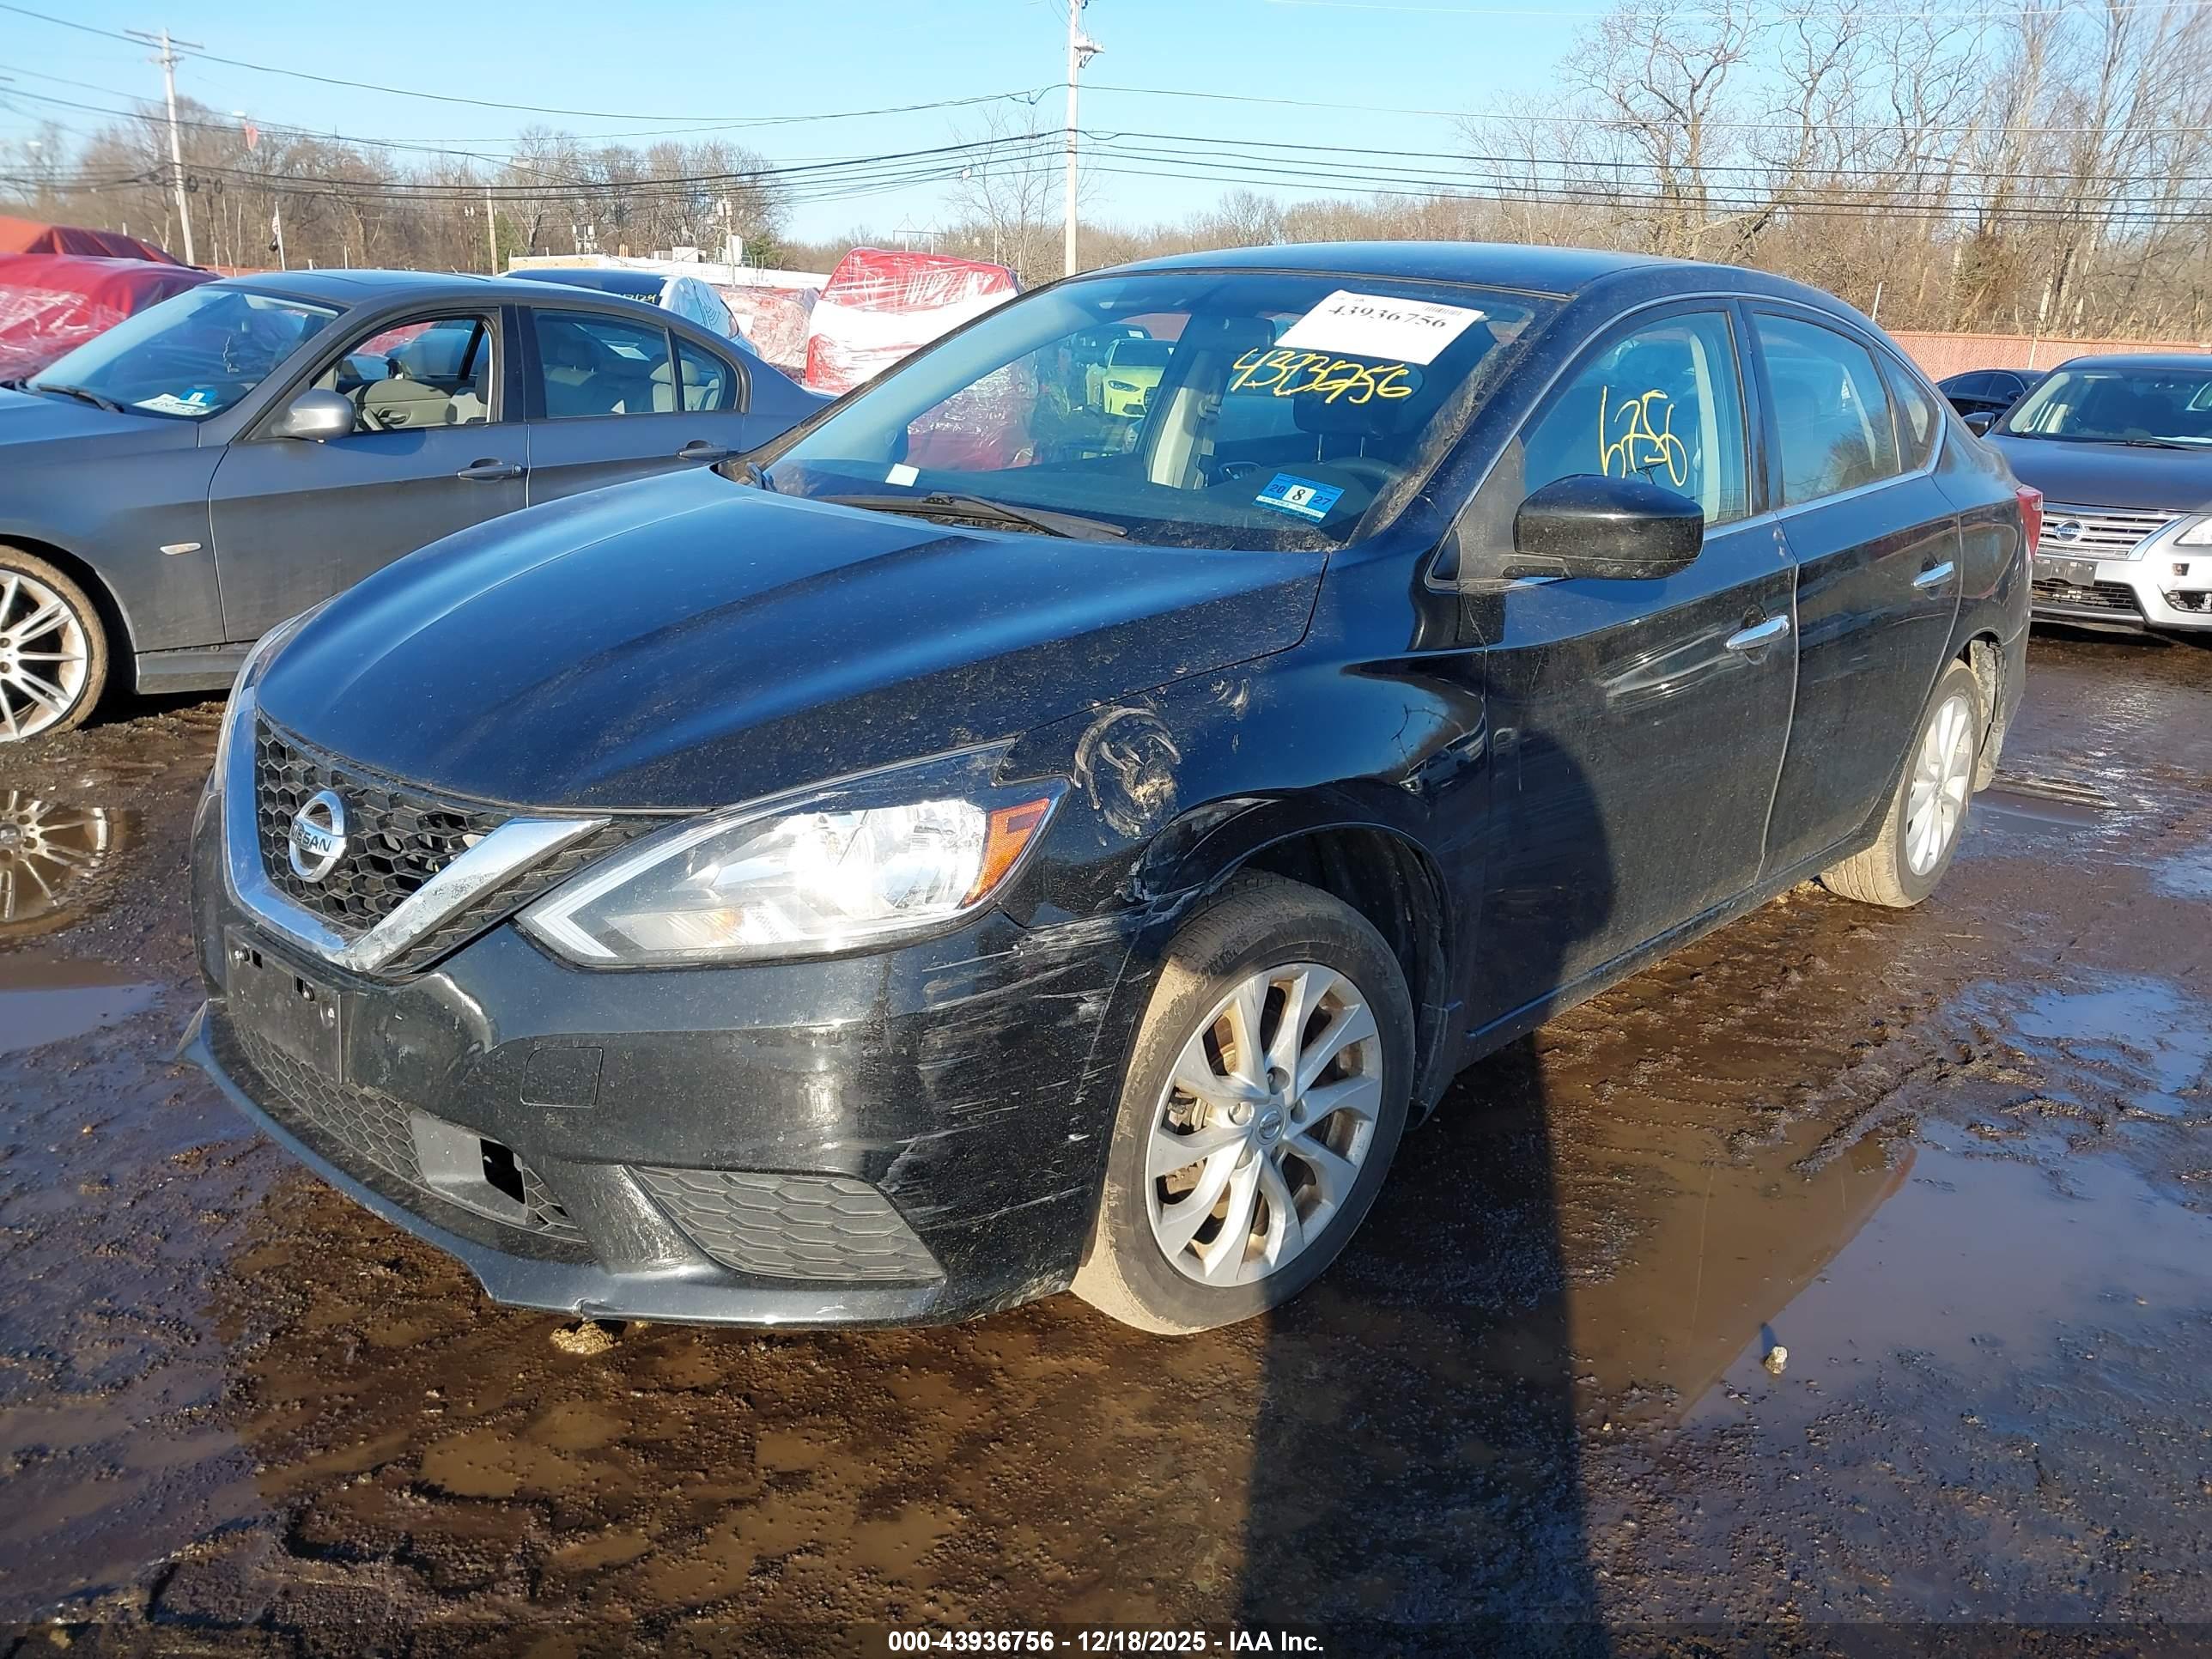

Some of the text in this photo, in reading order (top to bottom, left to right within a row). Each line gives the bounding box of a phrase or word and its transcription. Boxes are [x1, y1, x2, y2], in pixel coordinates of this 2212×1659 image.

[1328, 305, 1447, 328] 43936756
[1268, 483, 1332, 505] 20 8 27
[292, 823, 332, 853] NISSAN
